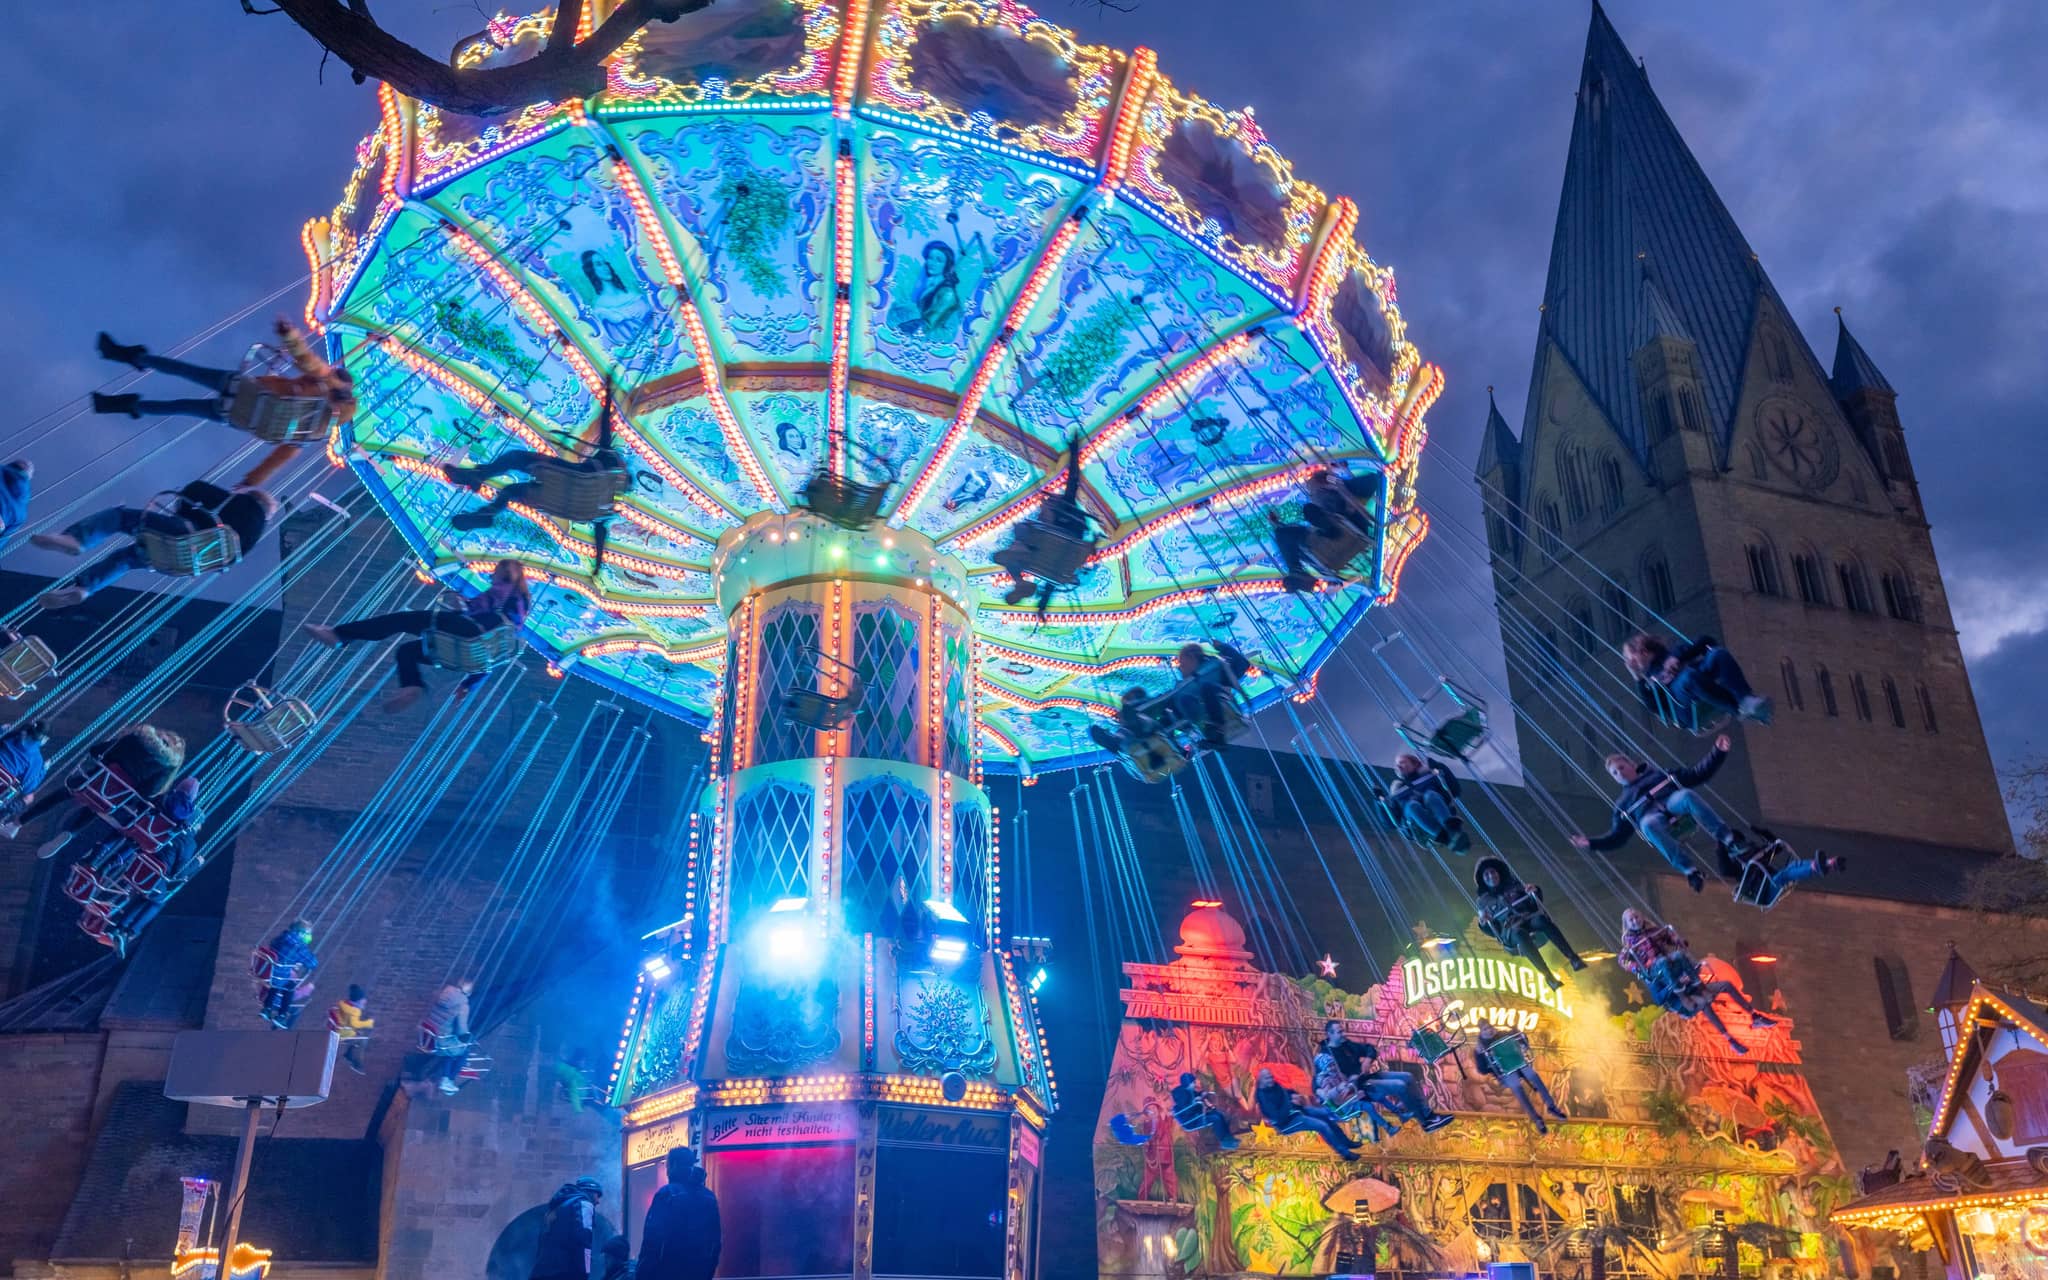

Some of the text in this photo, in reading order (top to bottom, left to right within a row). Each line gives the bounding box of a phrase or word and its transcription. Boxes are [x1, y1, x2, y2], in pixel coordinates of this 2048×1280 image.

[1403, 957, 1574, 1020] DSCHUNGEL
[710, 1117, 738, 1141] Bitte
[744, 1126, 772, 1138] nicht
